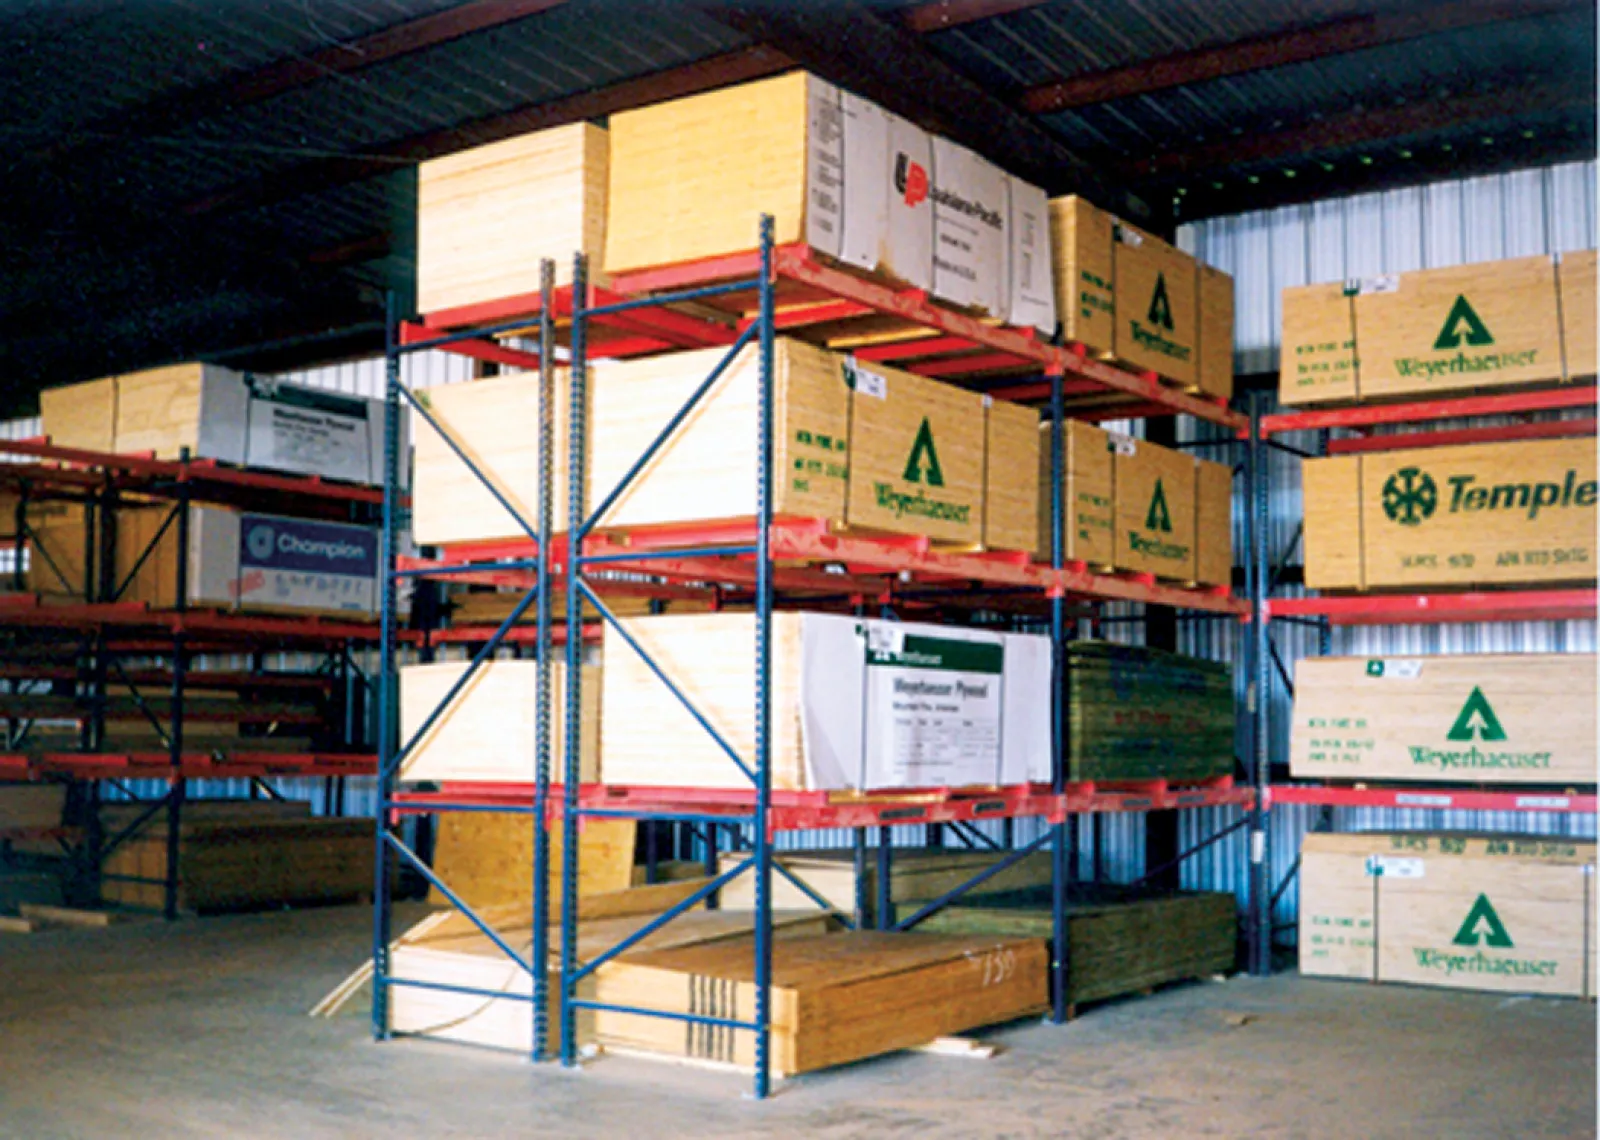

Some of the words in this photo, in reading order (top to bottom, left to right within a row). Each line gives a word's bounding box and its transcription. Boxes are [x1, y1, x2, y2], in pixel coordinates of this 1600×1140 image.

[1394, 349, 1538, 382] Weyerhaeuser
[1447, 470, 1597, 520] Temple
[278, 532, 366, 560] Champion
[1407, 745, 1552, 772] Weyerhaeuser
[1412, 947, 1558, 977] Weyerhaeuser
